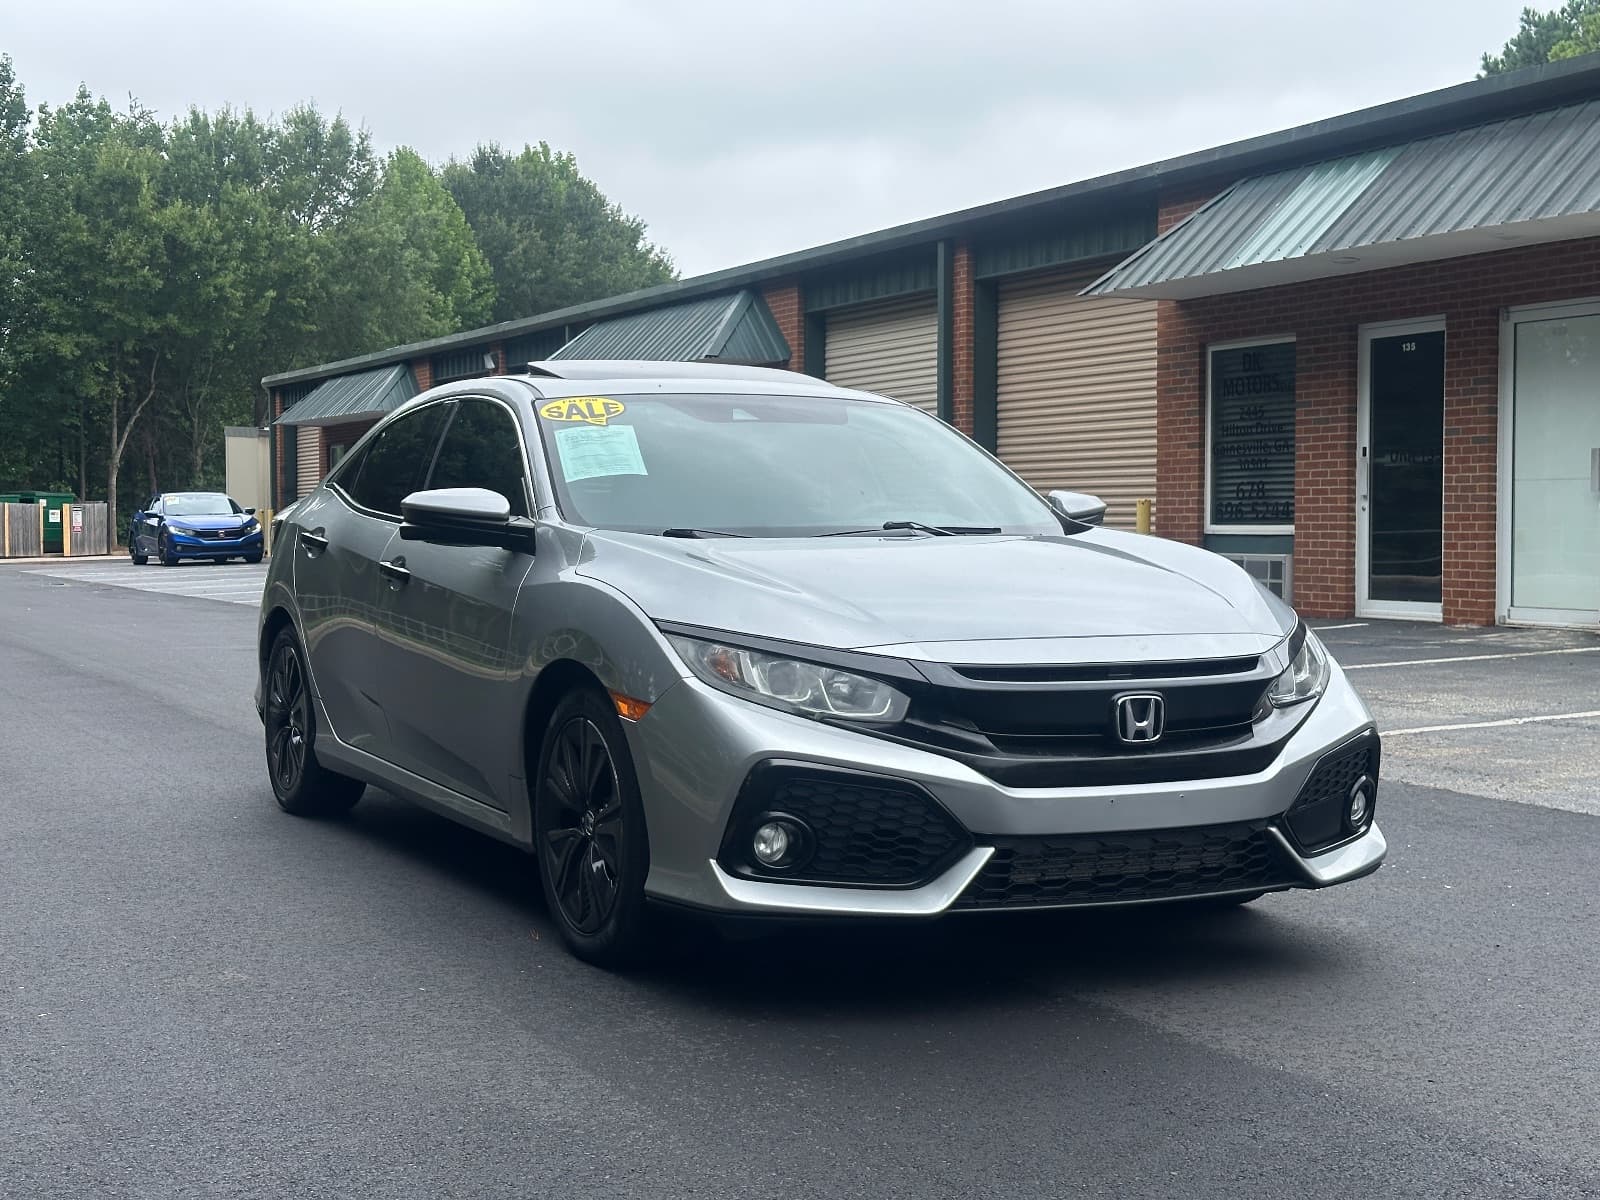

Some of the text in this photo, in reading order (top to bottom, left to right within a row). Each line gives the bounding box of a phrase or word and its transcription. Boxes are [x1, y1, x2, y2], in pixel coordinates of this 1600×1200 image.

[1402, 342, 1416, 352] 135
[1223, 373, 1280, 397] MOTORS
[545, 401, 621, 420] SALE
[1236, 481, 1265, 499] 678
